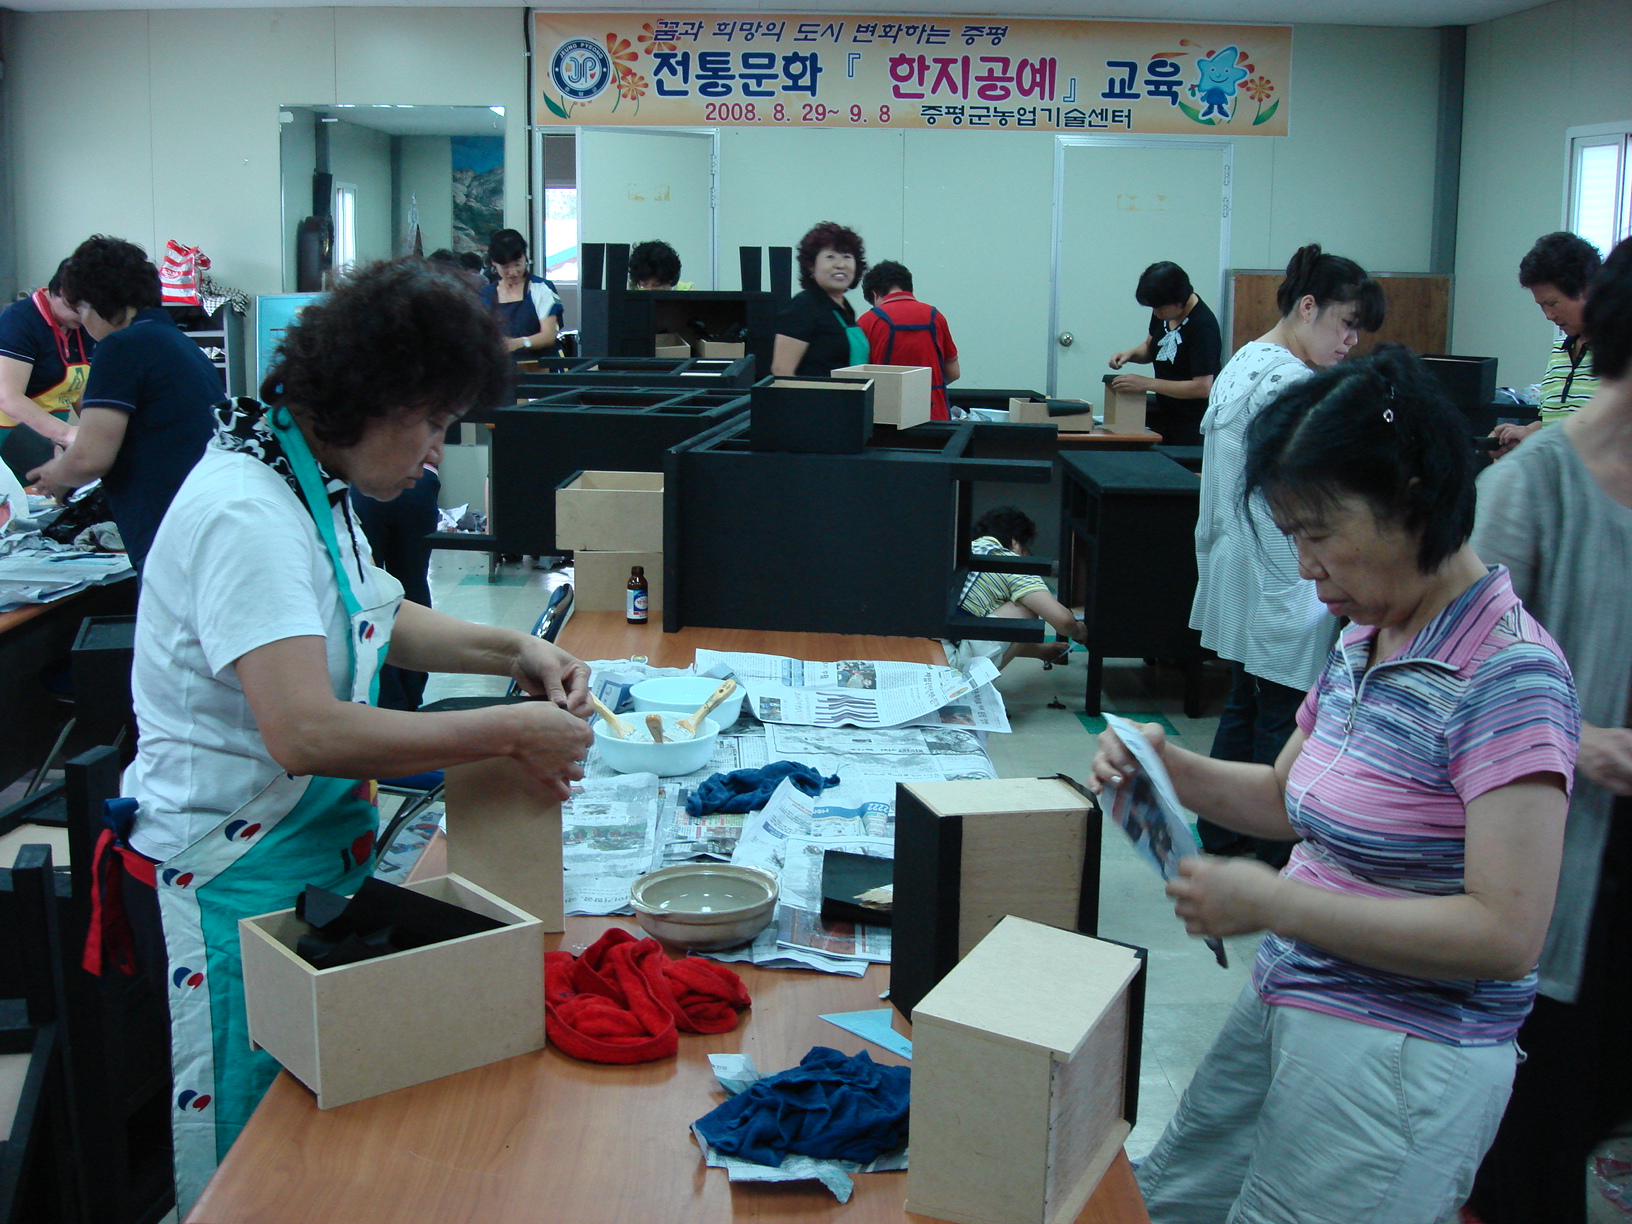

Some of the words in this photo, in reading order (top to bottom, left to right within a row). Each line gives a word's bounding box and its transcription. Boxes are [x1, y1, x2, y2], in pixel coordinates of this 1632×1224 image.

[653, 20, 704, 43] 꿈과
[712, 20, 787, 43] 희망의
[793, 22, 844, 43] 도시
[851, 22, 951, 46] 변화하는
[960, 25, 1009, 46] 증평
[652, 51, 824, 98] 전통문화
[1100, 59, 1185, 105] 교육
[704, 103, 763, 122] 2008.
[773, 103, 791, 122] 8.
[849, 104, 868, 123] 9.
[878, 104, 891, 123] 8
[920, 105, 1132, 129] 증평군농업기술센터
